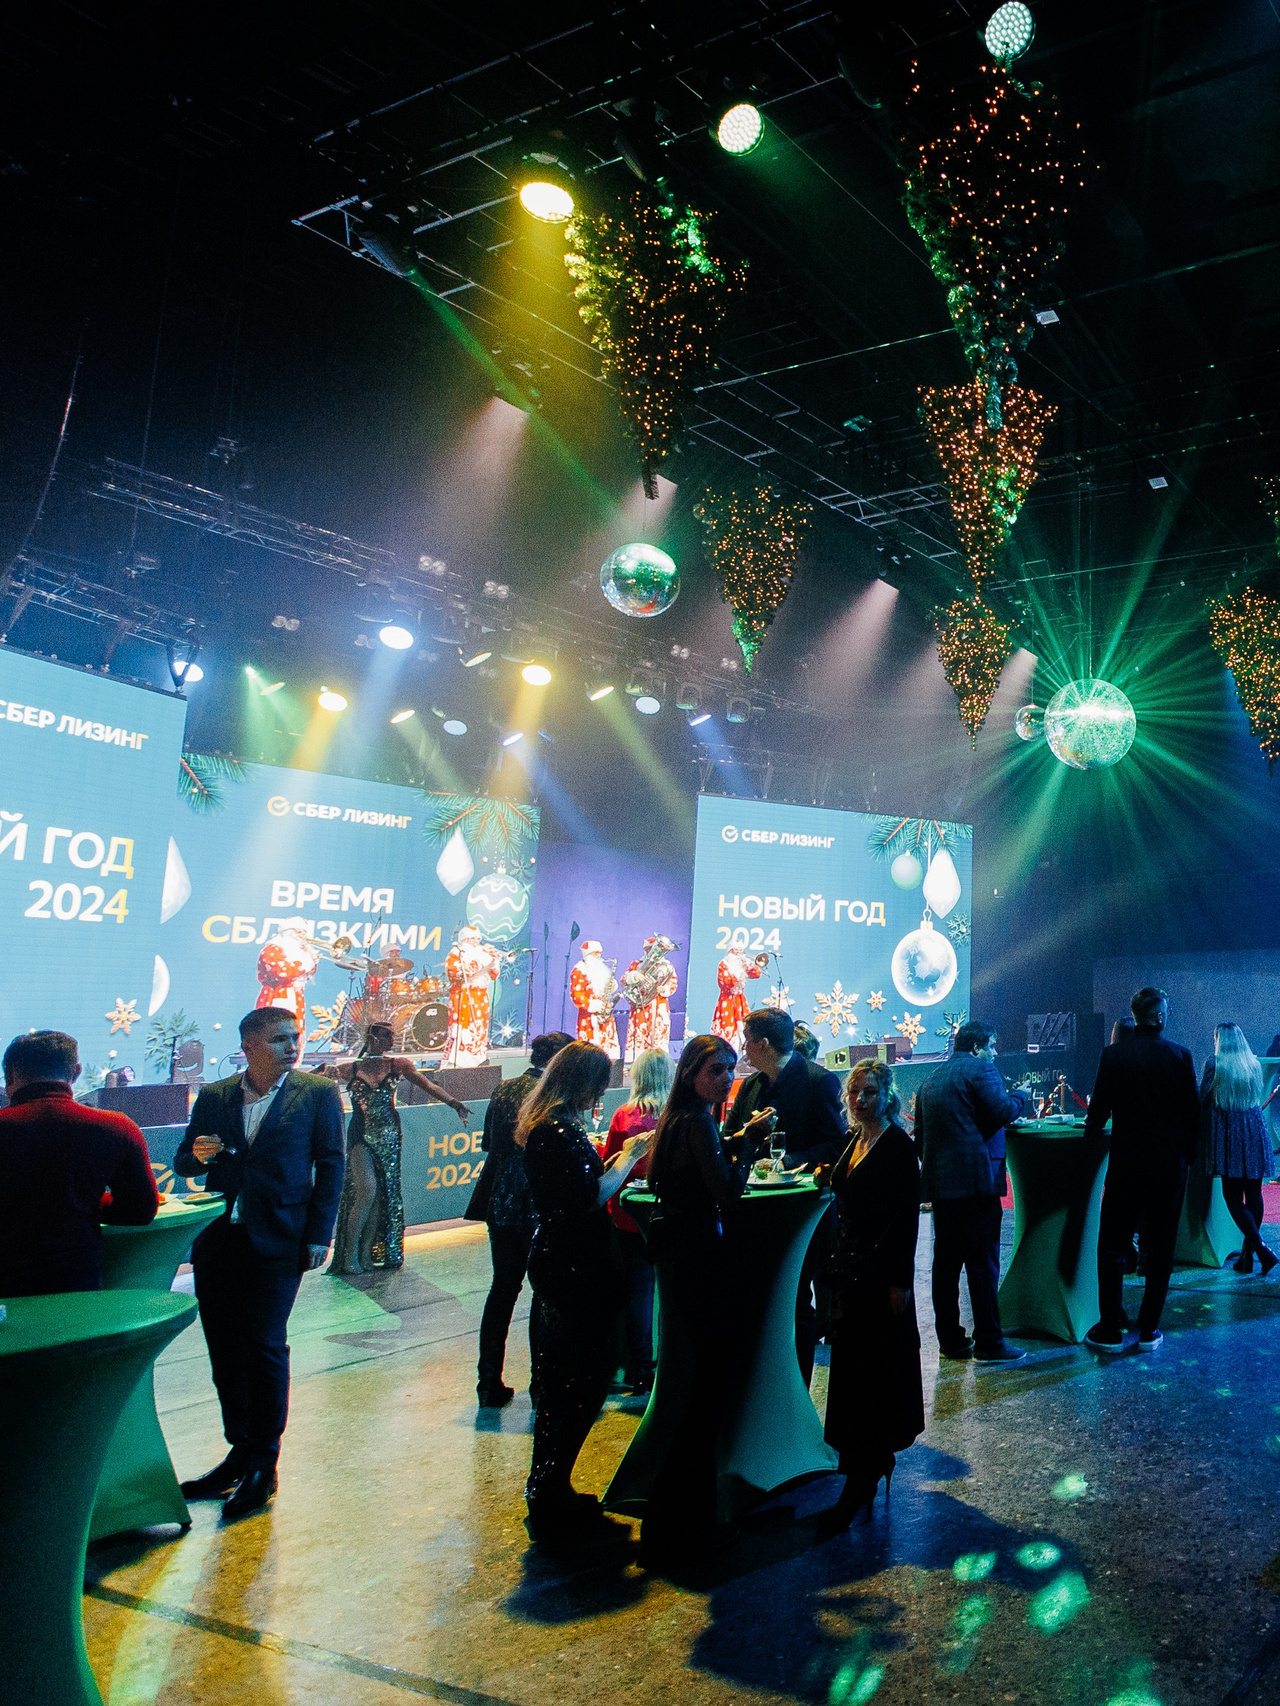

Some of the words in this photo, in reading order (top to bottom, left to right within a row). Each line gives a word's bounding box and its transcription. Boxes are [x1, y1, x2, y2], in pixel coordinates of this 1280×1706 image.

[56, 714, 149, 750] ЛИЗИНГ
[292, 802, 342, 820] СБЕР
[342, 808, 413, 829] ЛИЗИНГ
[42, 826, 135, 880] ГОД
[741, 829, 779, 844] СБЕР
[779, 832, 836, 849] ЛИЗИНГ
[24, 879, 129, 924] 2024
[270, 879, 395, 914] ВРЕМЯ
[718, 893, 826, 922] НОВЫЙ
[834, 899, 886, 927] ГОД
[201, 914, 442, 951] СБЛЗКИМИ
[715, 926, 782, 951] 2024
